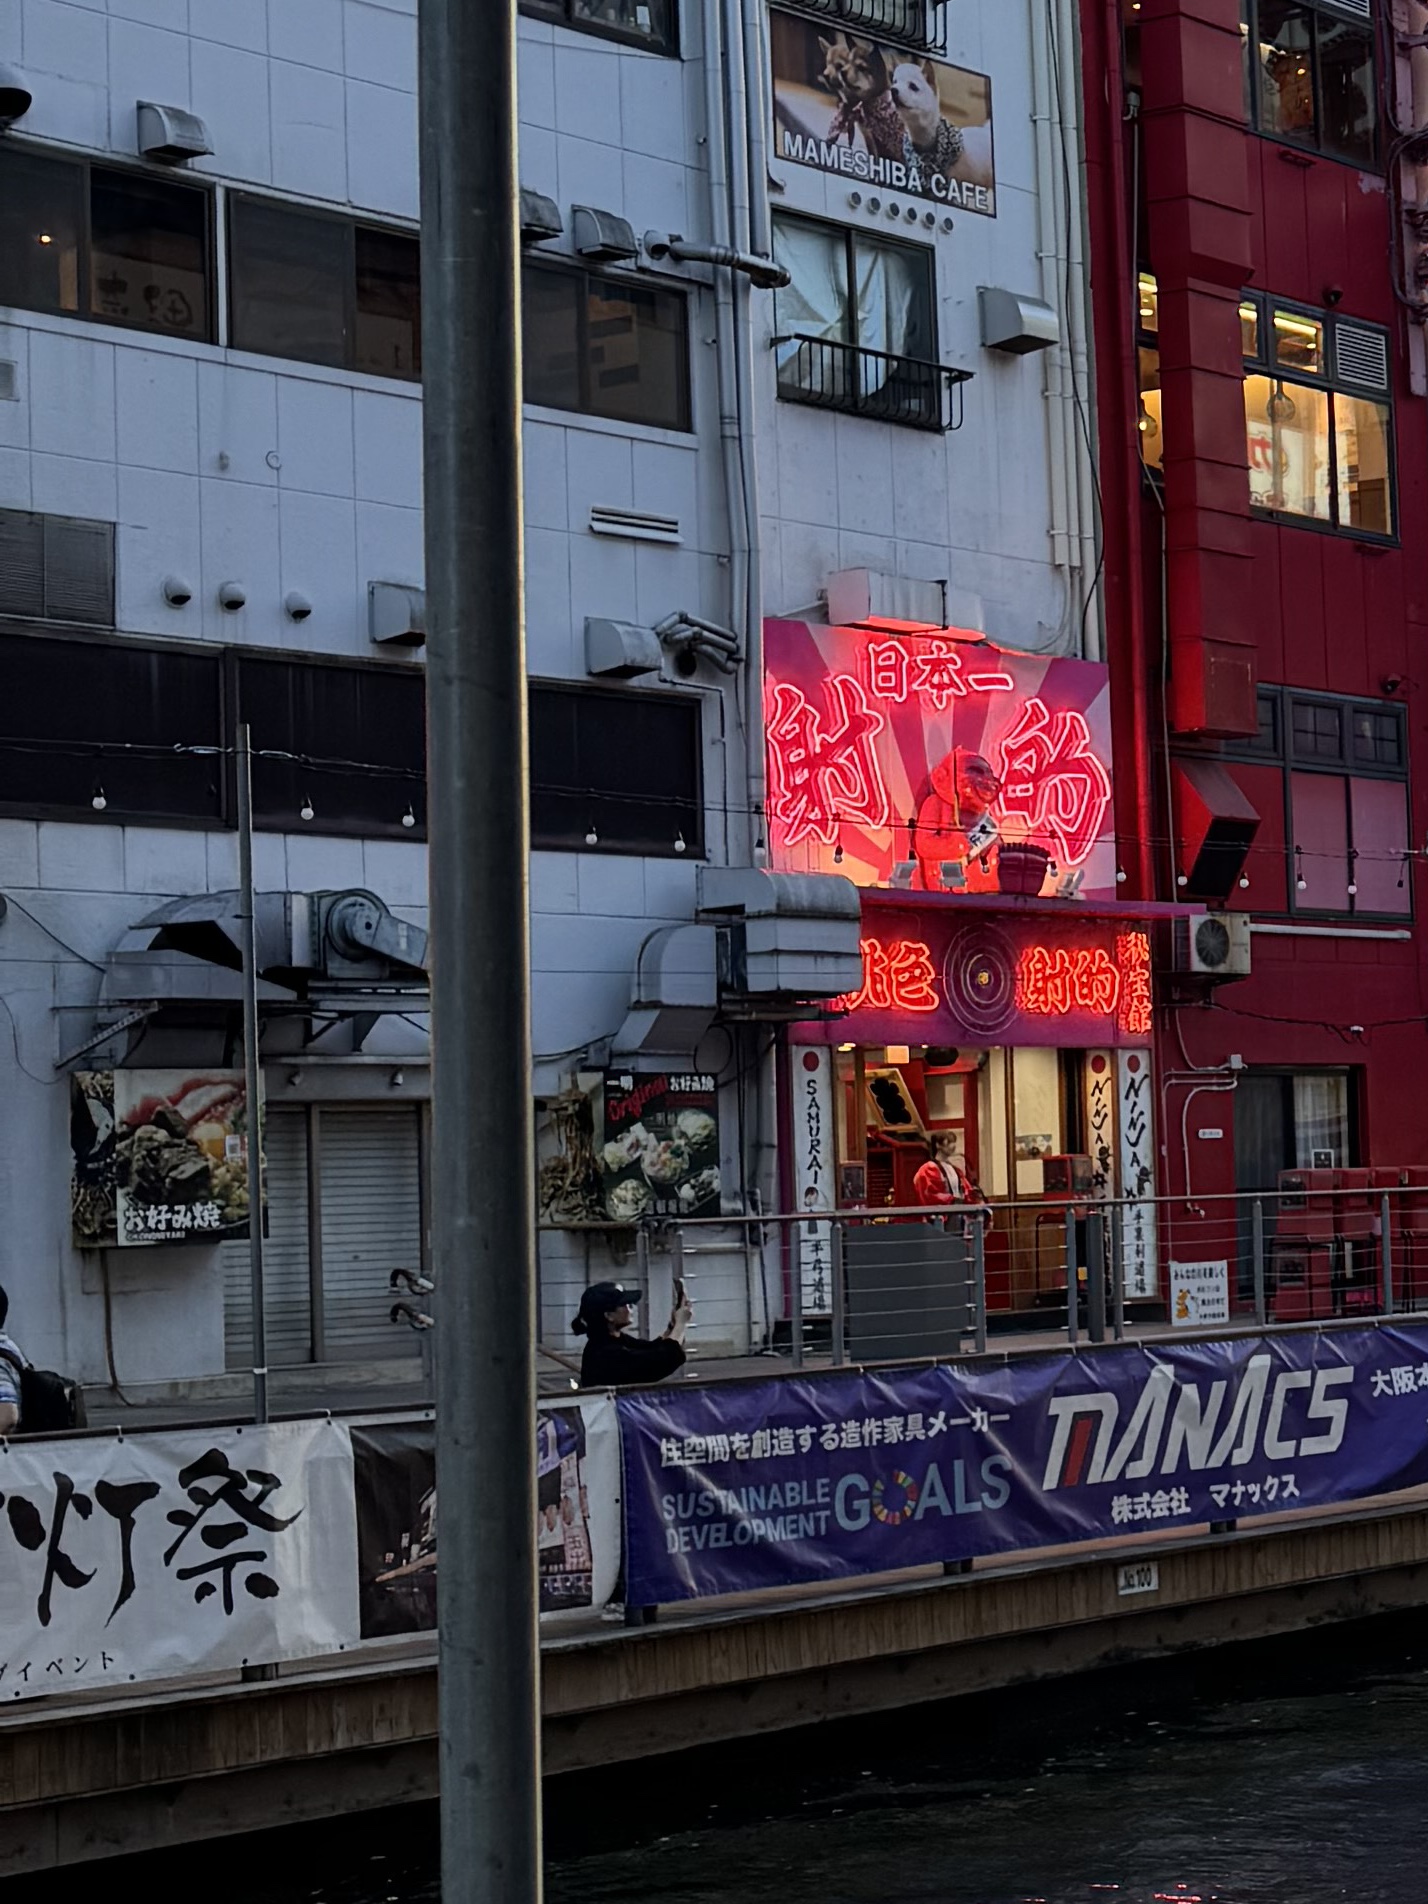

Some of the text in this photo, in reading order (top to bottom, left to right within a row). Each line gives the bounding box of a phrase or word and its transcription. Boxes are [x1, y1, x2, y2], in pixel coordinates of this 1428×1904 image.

[783, 129, 989, 211] MAMESHIBA CAFE
[867, 639, 1015, 710] 日本一
[805, 1079, 825, 1186] SAMURAI
[1124, 1073, 1149, 1168] NINJA
[124, 1200, 222, 1232] お好み焼
[660, 1405, 1011, 1469] 住空間を創造する造作家具メーカー
[660, 1476, 832, 1522] SUSTAINABLE
[834, 1454, 1014, 1533] GOALS
[1110, 1474, 1301, 1525] 株式会社 マナックス
[665, 1509, 832, 1556] DEVELOPMENT
